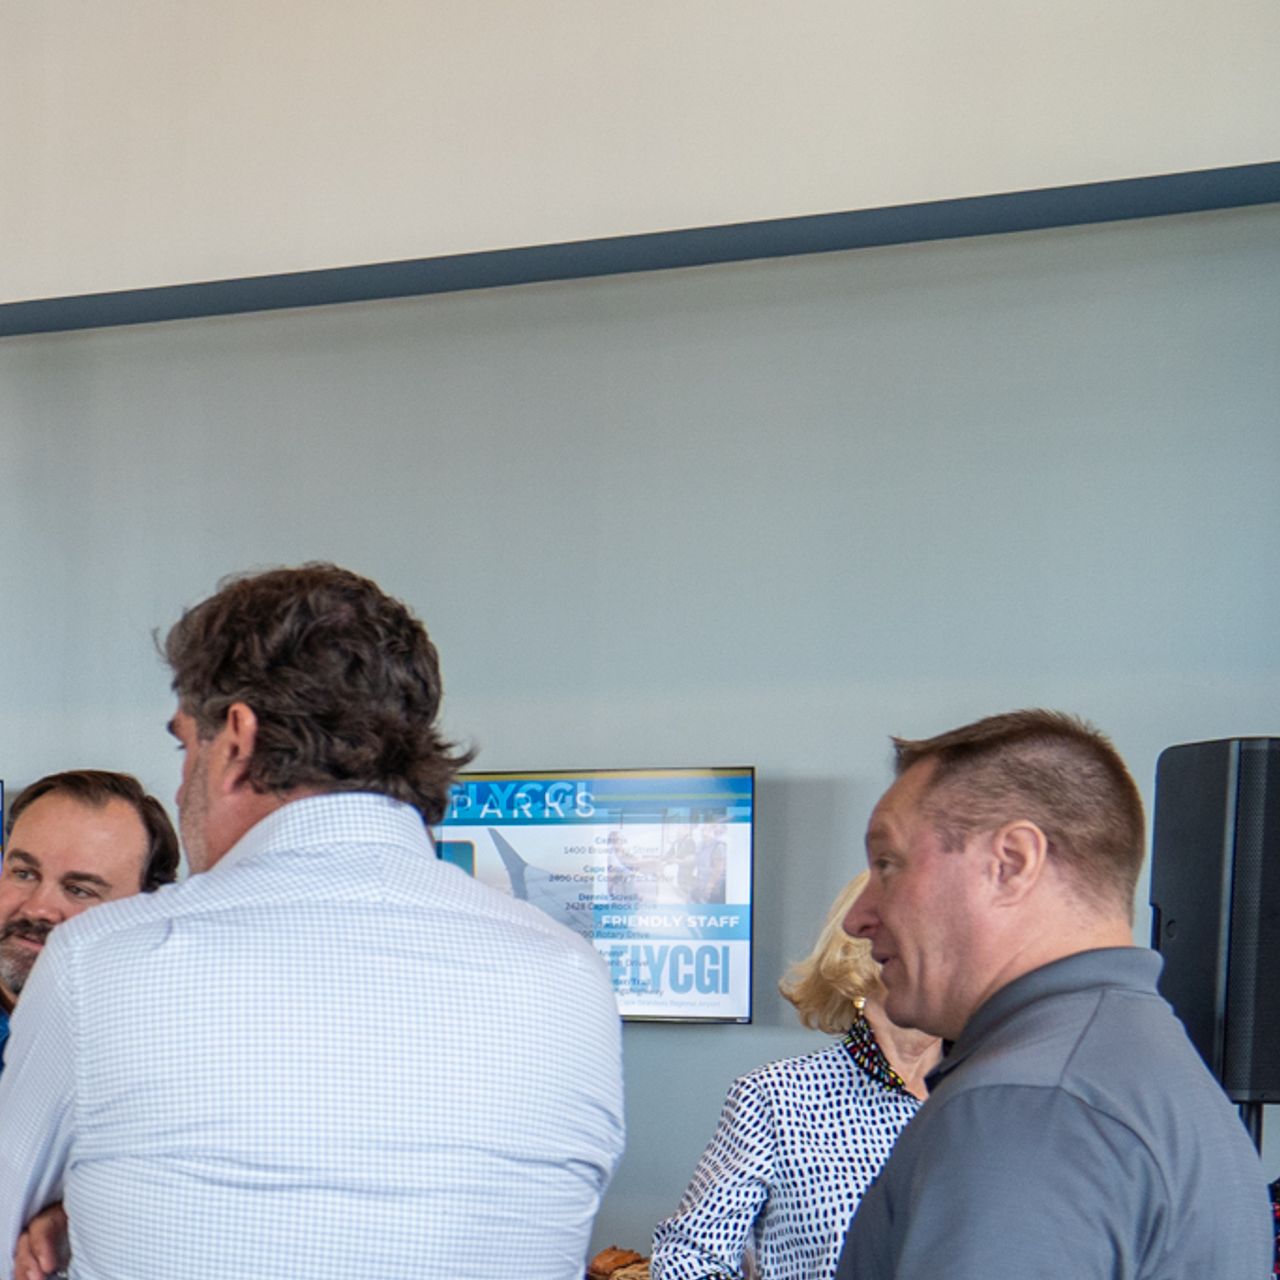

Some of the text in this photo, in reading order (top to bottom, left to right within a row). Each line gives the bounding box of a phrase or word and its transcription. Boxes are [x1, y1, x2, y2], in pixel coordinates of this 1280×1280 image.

[601, 915, 685, 928] FRIENDLY
[687, 915, 739, 928] STAFF
[610, 944, 730, 995] FLYCGI
